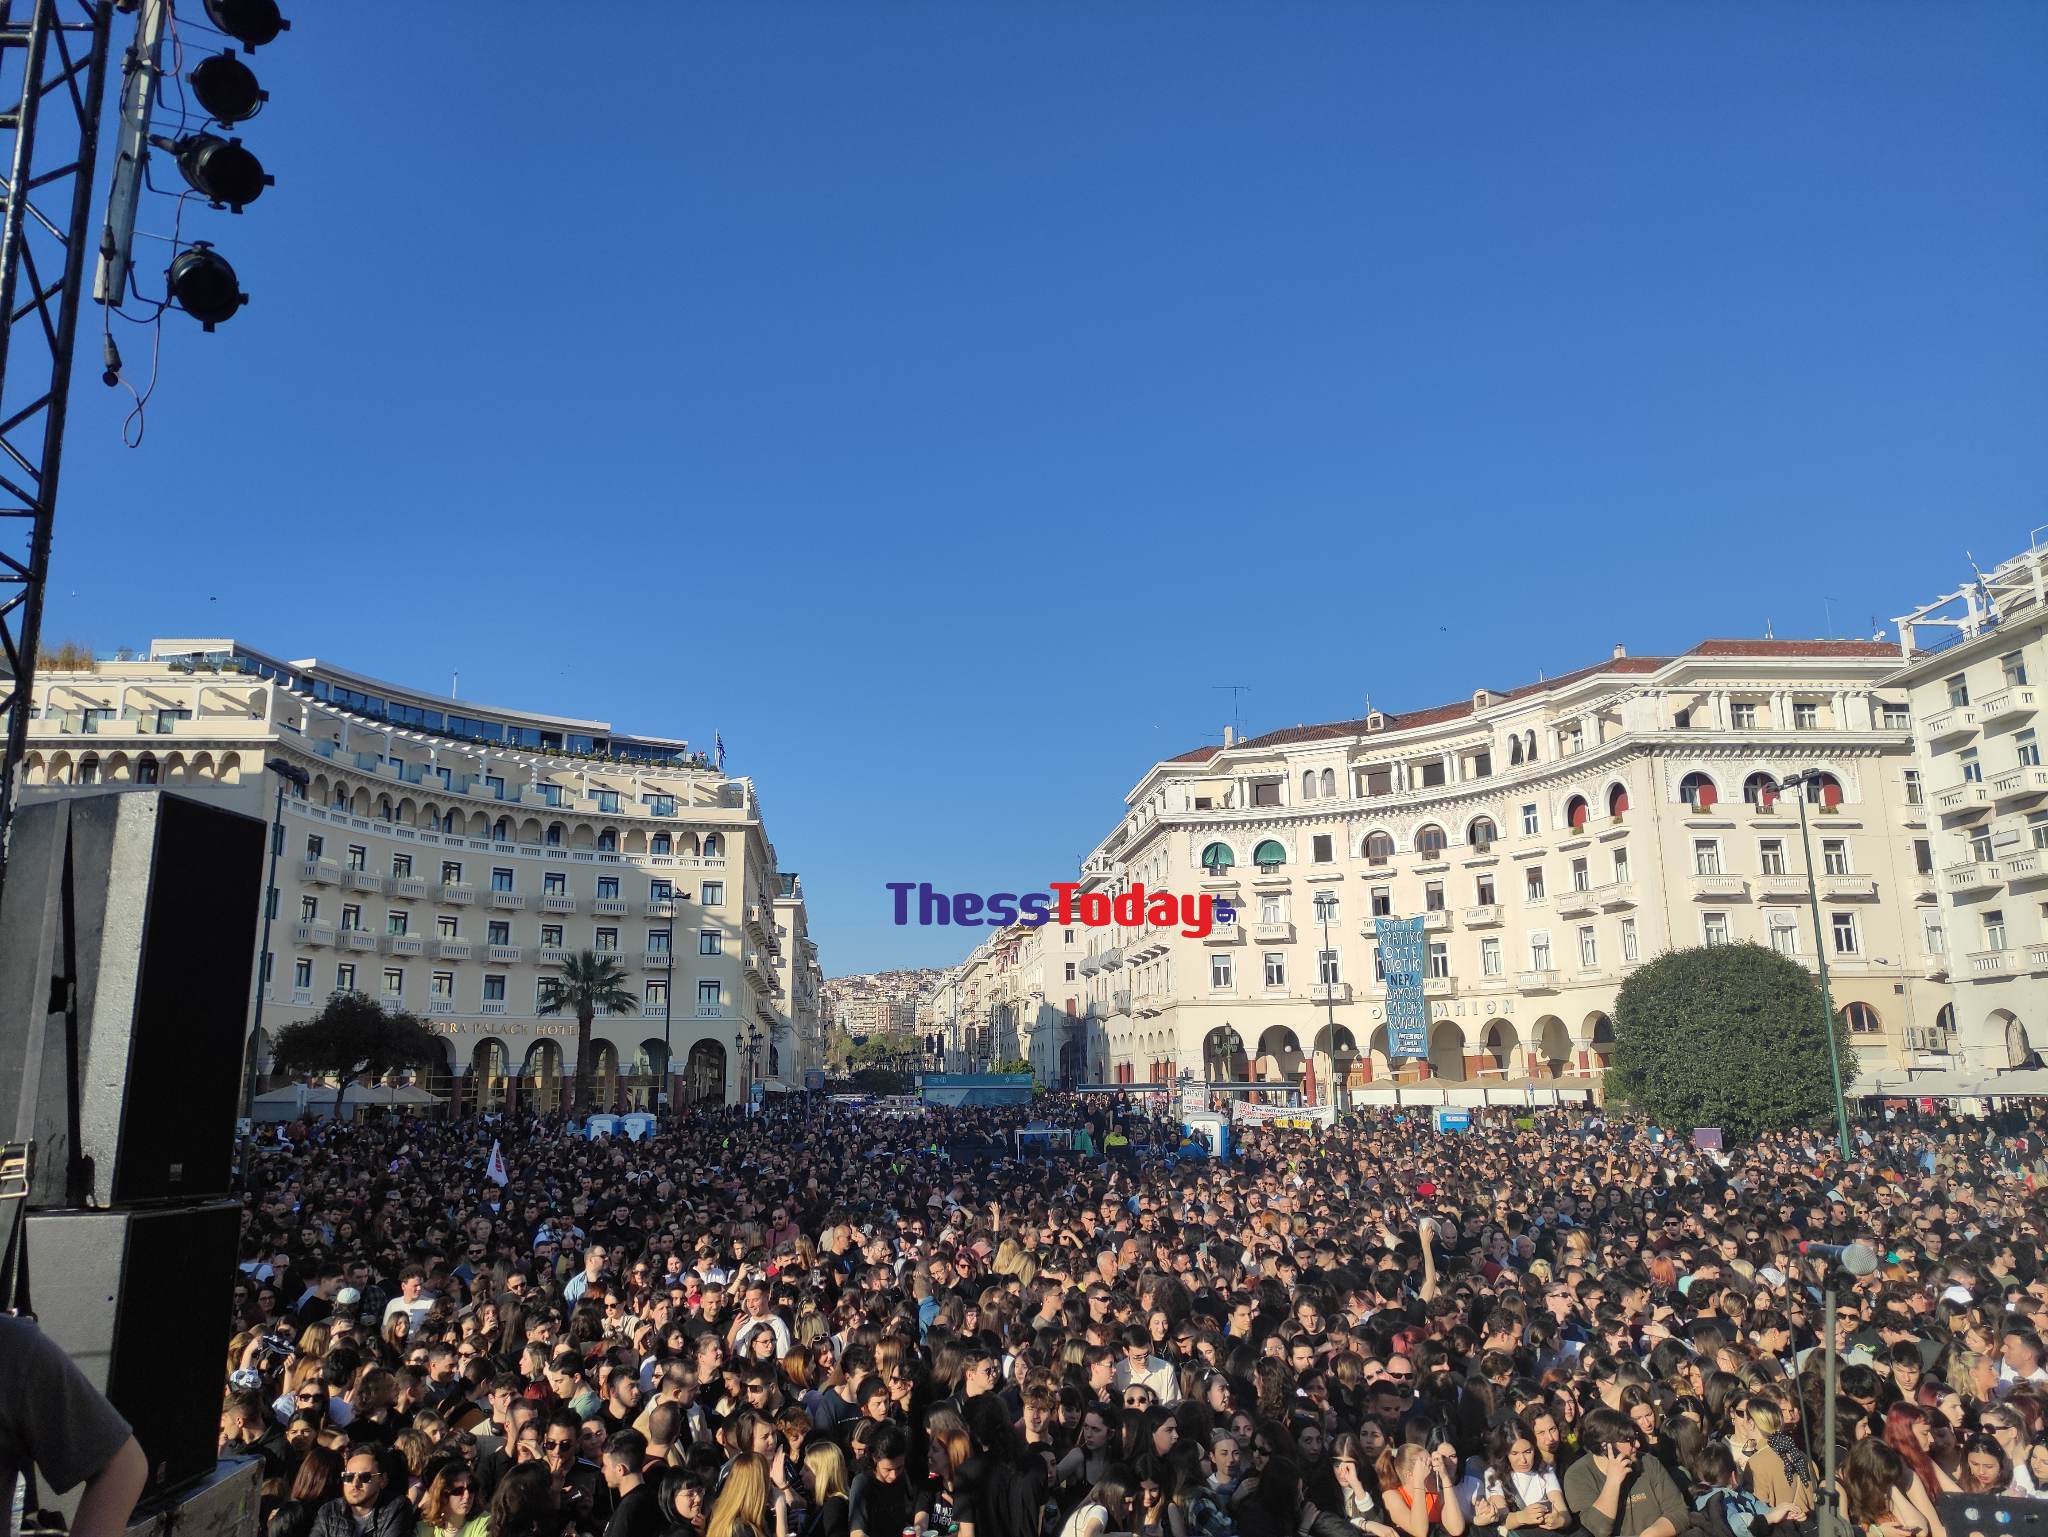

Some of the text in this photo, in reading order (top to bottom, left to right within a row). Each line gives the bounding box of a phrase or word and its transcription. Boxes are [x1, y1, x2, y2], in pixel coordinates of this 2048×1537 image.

[1383, 920, 1414, 931] ΟΥΤΕ
[1379, 931, 1422, 946] ΚΡΑΤΙΚΟ
[1385, 946, 1417, 959] ΟΥΤΕ
[473, 1023, 529, 1035] PALACE
